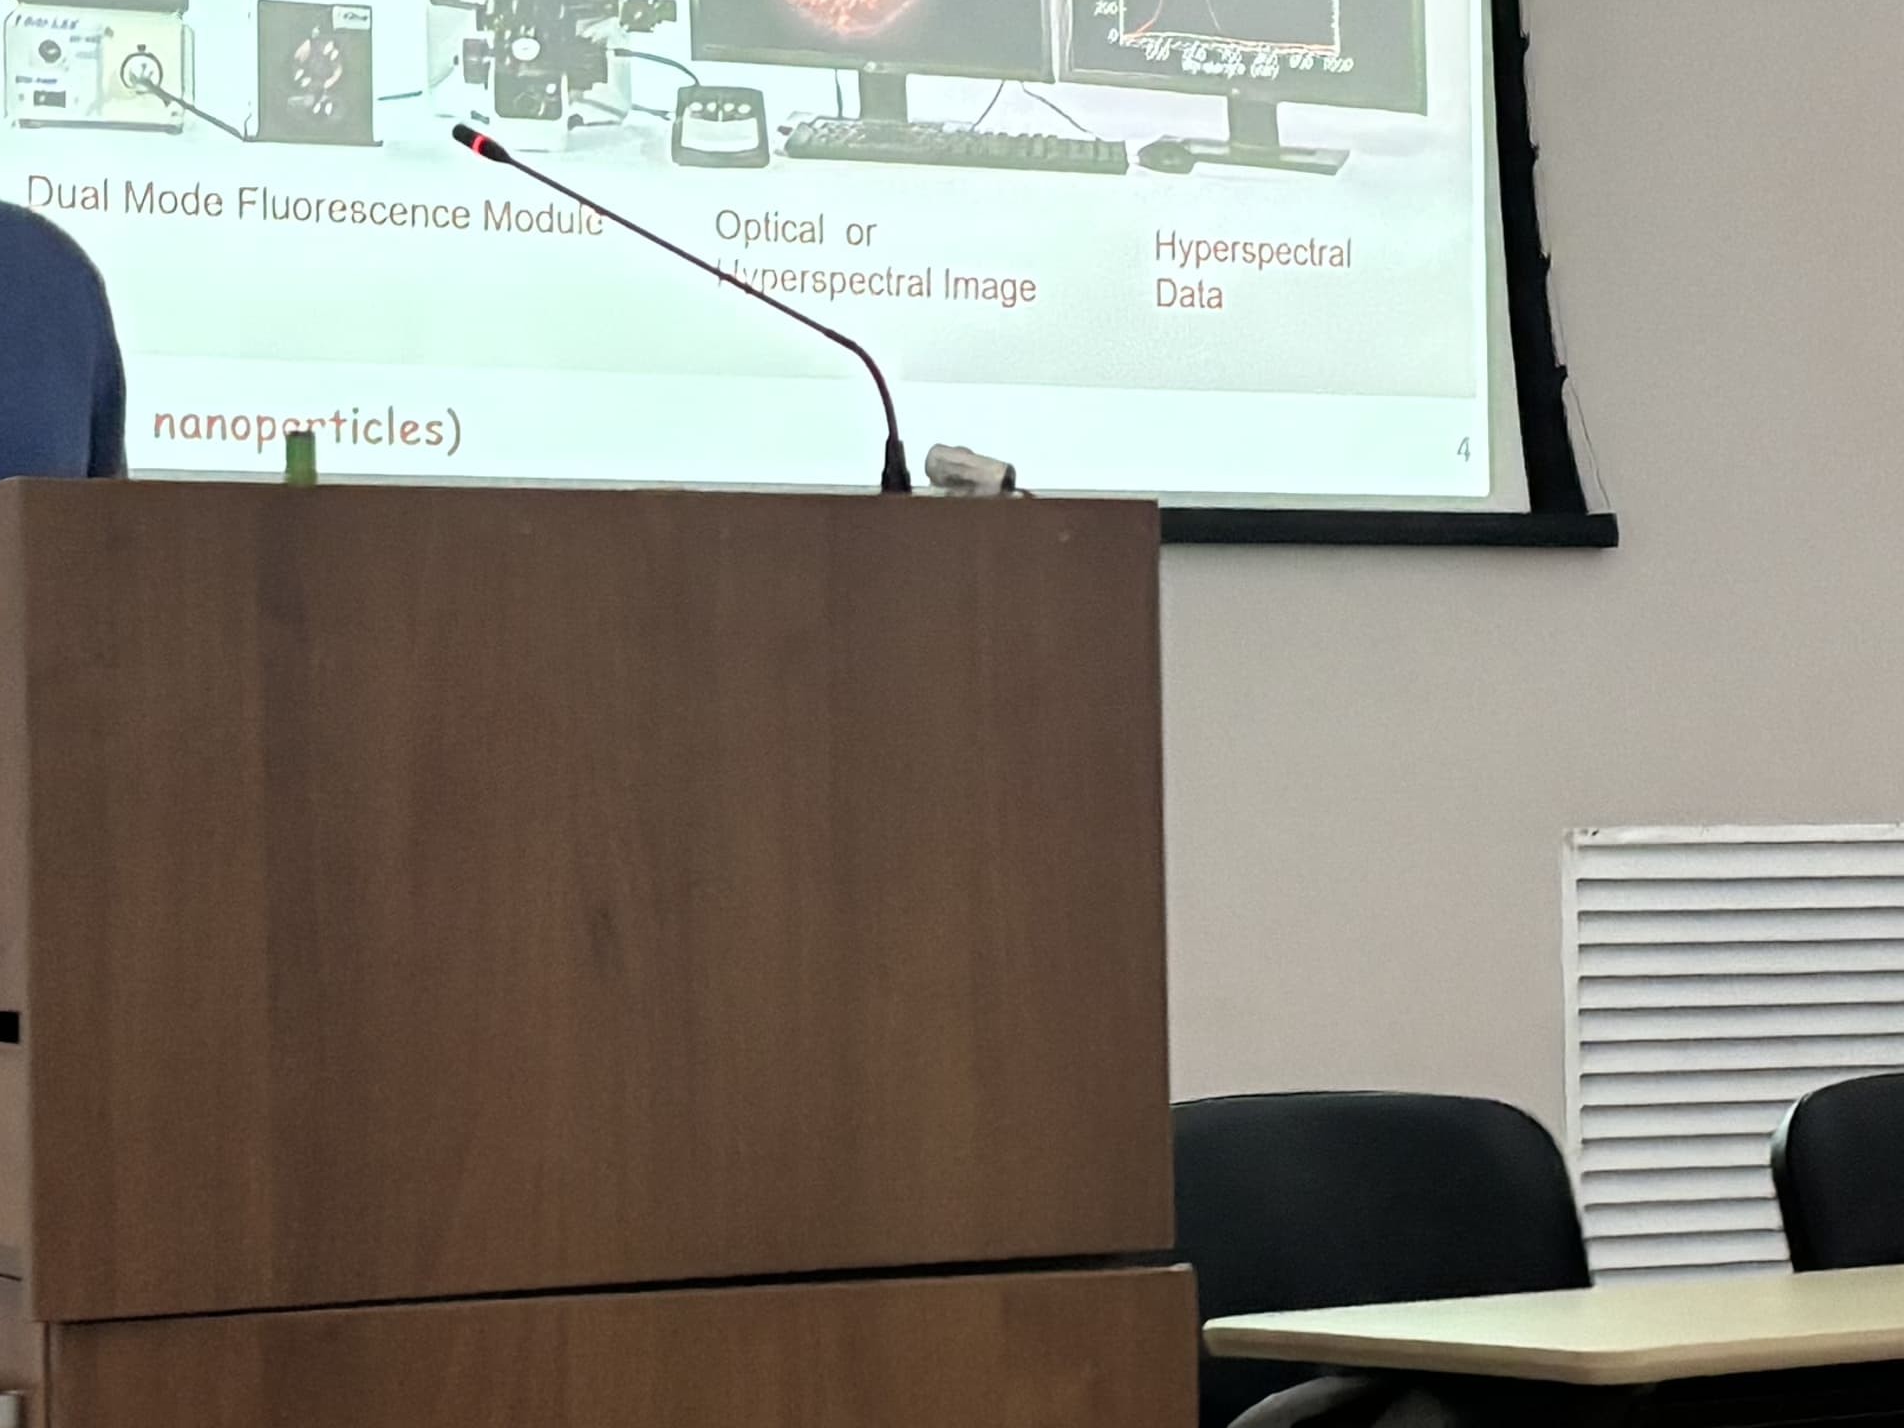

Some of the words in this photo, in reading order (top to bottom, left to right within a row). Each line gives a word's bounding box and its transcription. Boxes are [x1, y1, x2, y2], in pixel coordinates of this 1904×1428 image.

[27, 175, 109, 211] Dual
[124, 180, 223, 217] Mode
[238, 186, 470, 230] Fluorescence
[483, 199, 603, 236] Module
[715, 209, 824, 250] Optical
[846, 220, 878, 247] or
[1155, 229, 1352, 277] Hyperspectral
[944, 267, 1038, 309] Image
[1156, 278, 1224, 311] Data
[1456, 436, 1471, 463] 4
